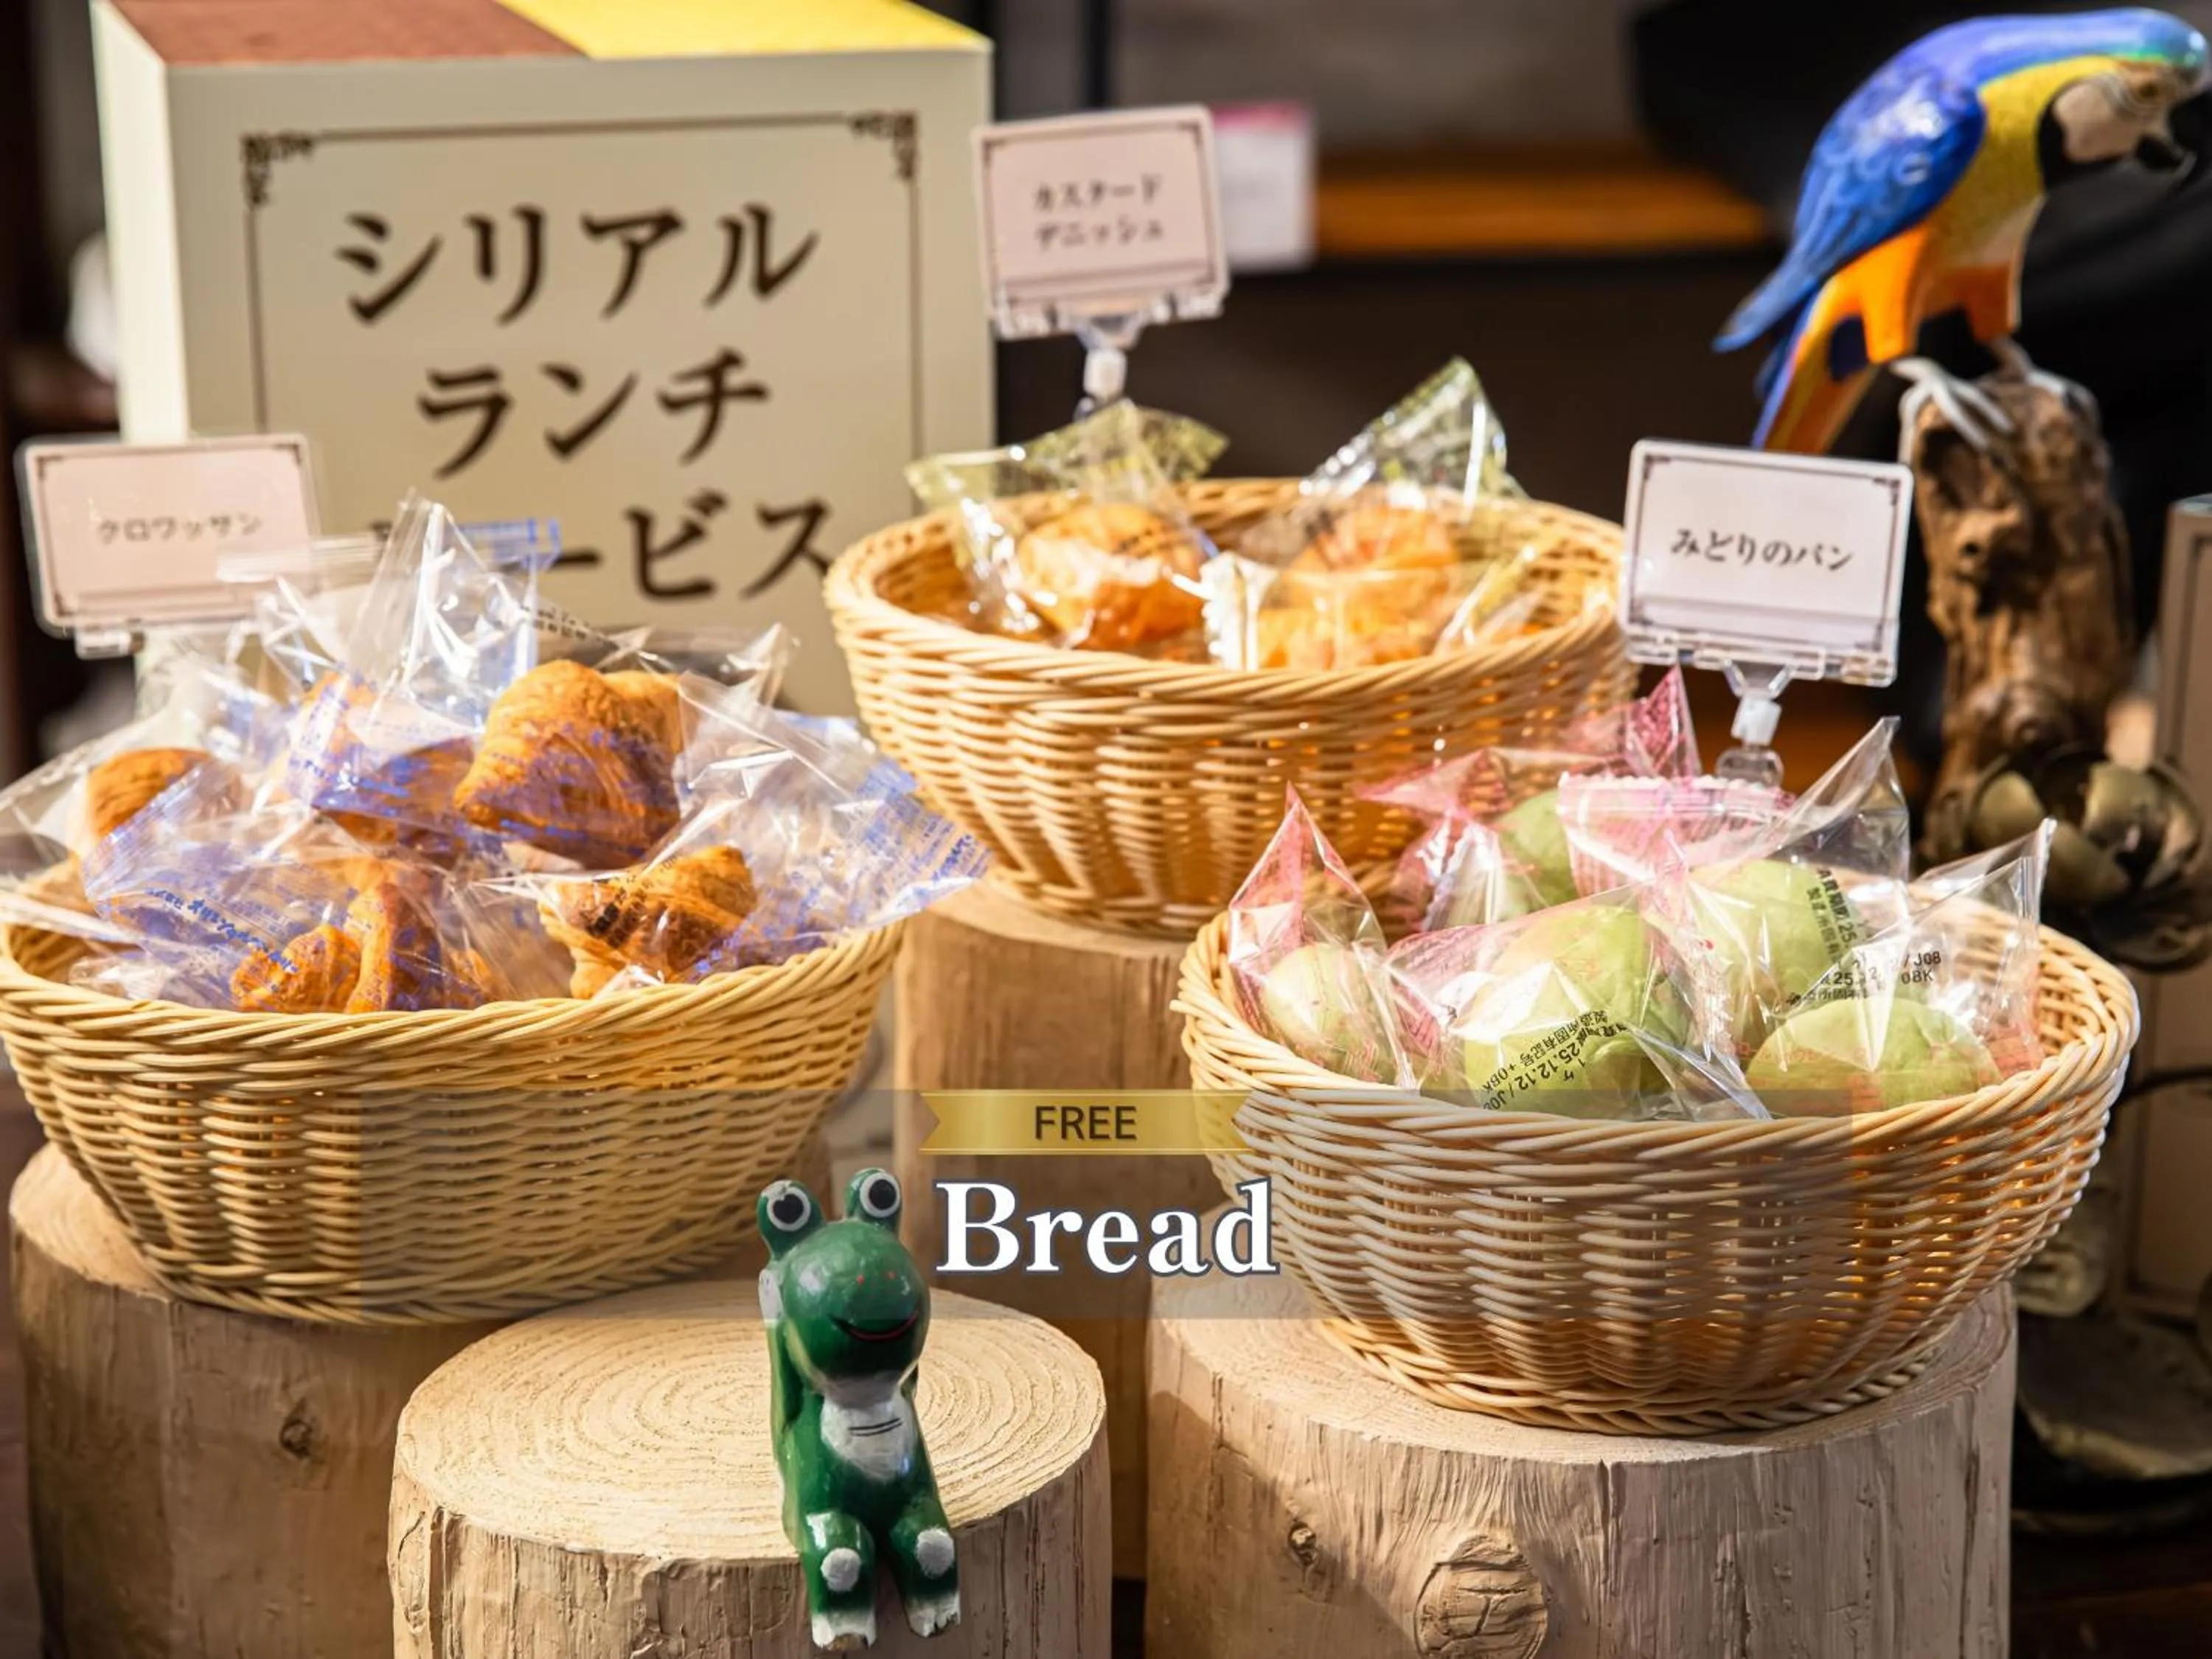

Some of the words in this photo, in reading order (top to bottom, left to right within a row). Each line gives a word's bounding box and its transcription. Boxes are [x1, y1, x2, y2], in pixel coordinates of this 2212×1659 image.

[334, 204, 819, 326] シリアル
[417, 348, 771, 479] ランチ
[97, 512, 263, 546] クロワッサン
[370, 488, 830, 601] ービス
[1671, 529, 1854, 571] みどりのパン
